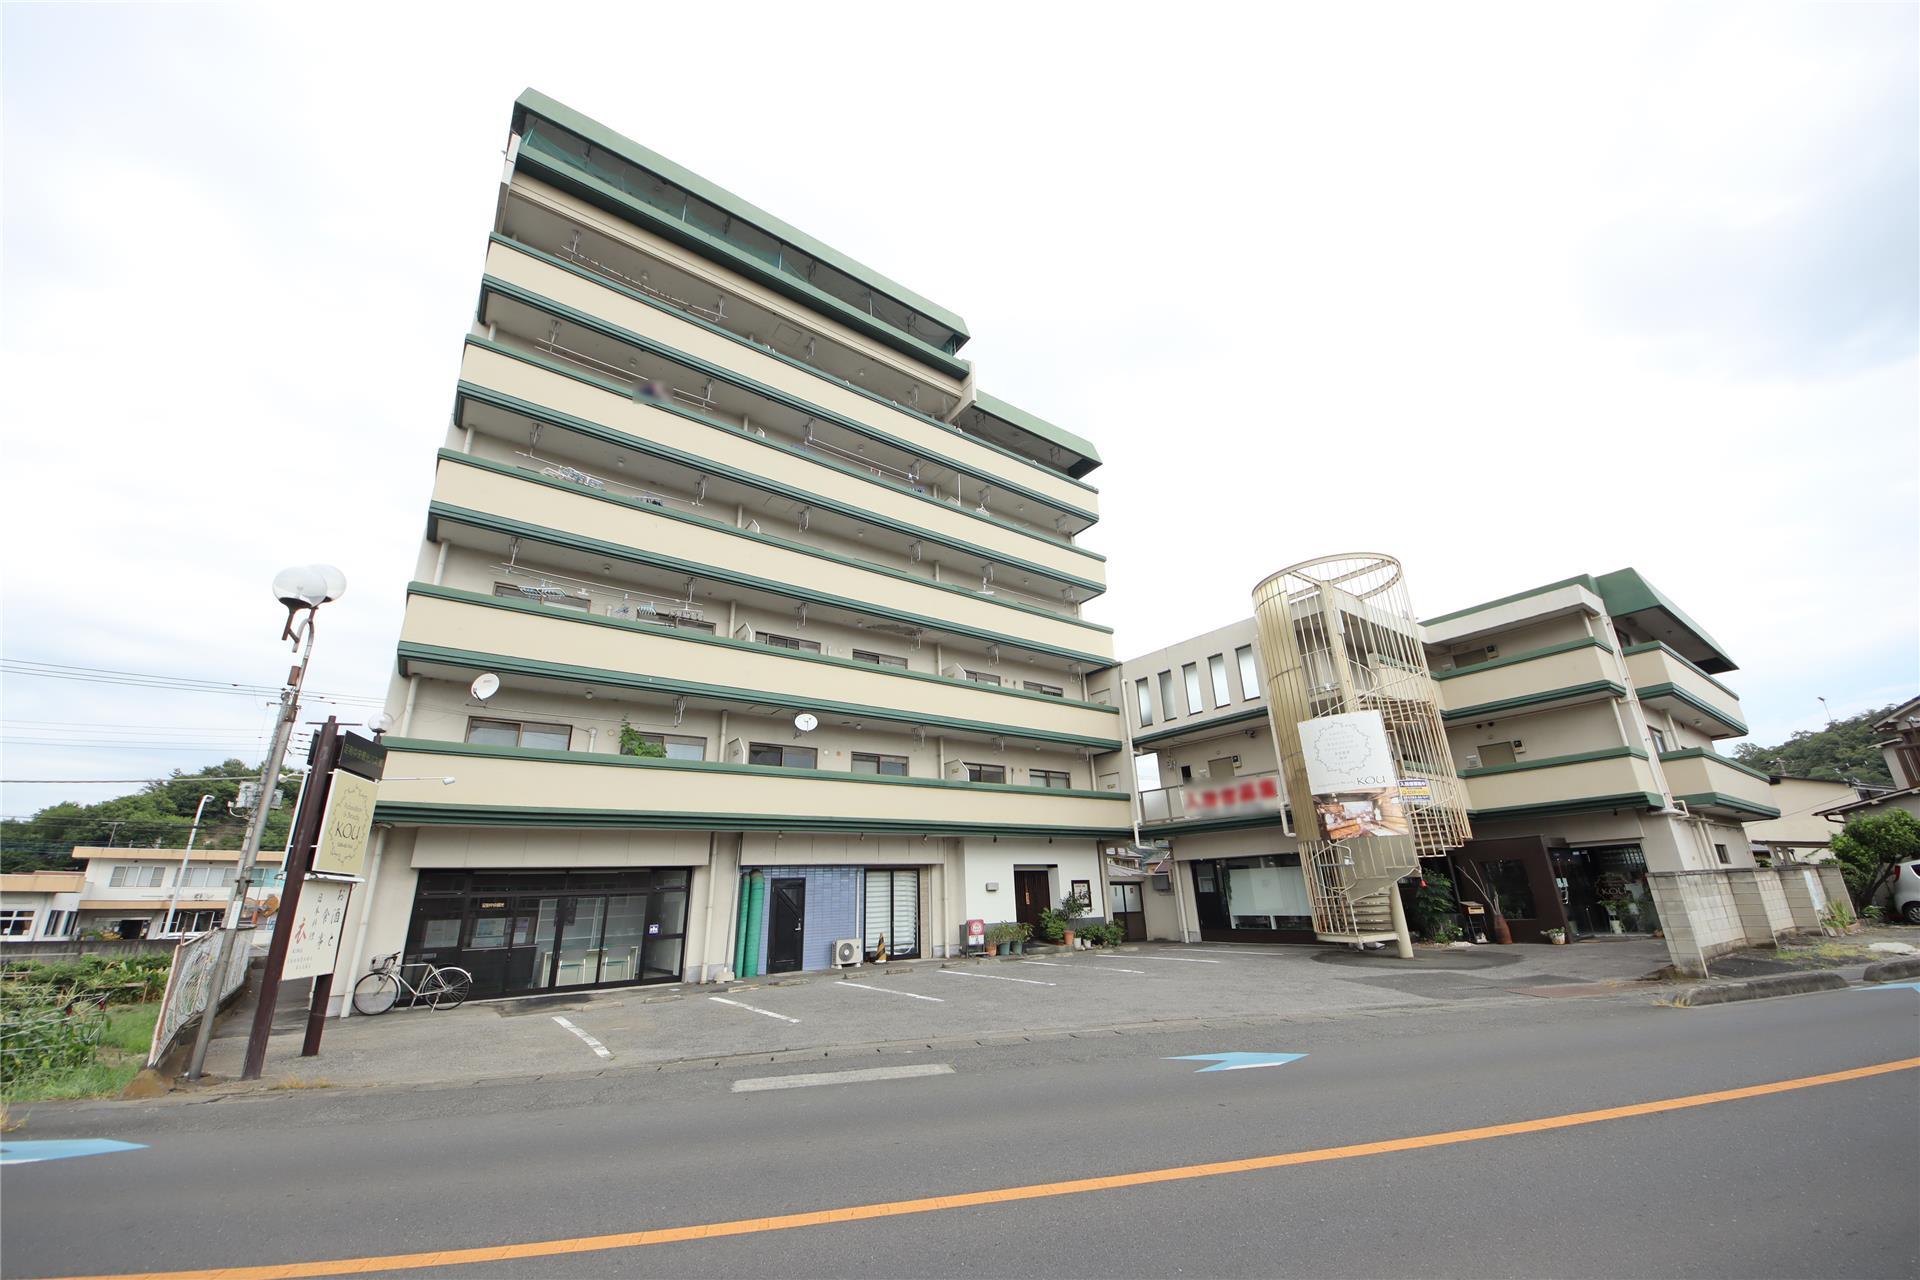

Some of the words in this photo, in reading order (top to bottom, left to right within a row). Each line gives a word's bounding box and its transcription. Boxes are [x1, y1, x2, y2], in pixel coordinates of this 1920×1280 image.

[1357, 776, 1386, 785] KOU
[335, 821, 361, 840] KOU
[327, 889, 345, 946] お酒と
